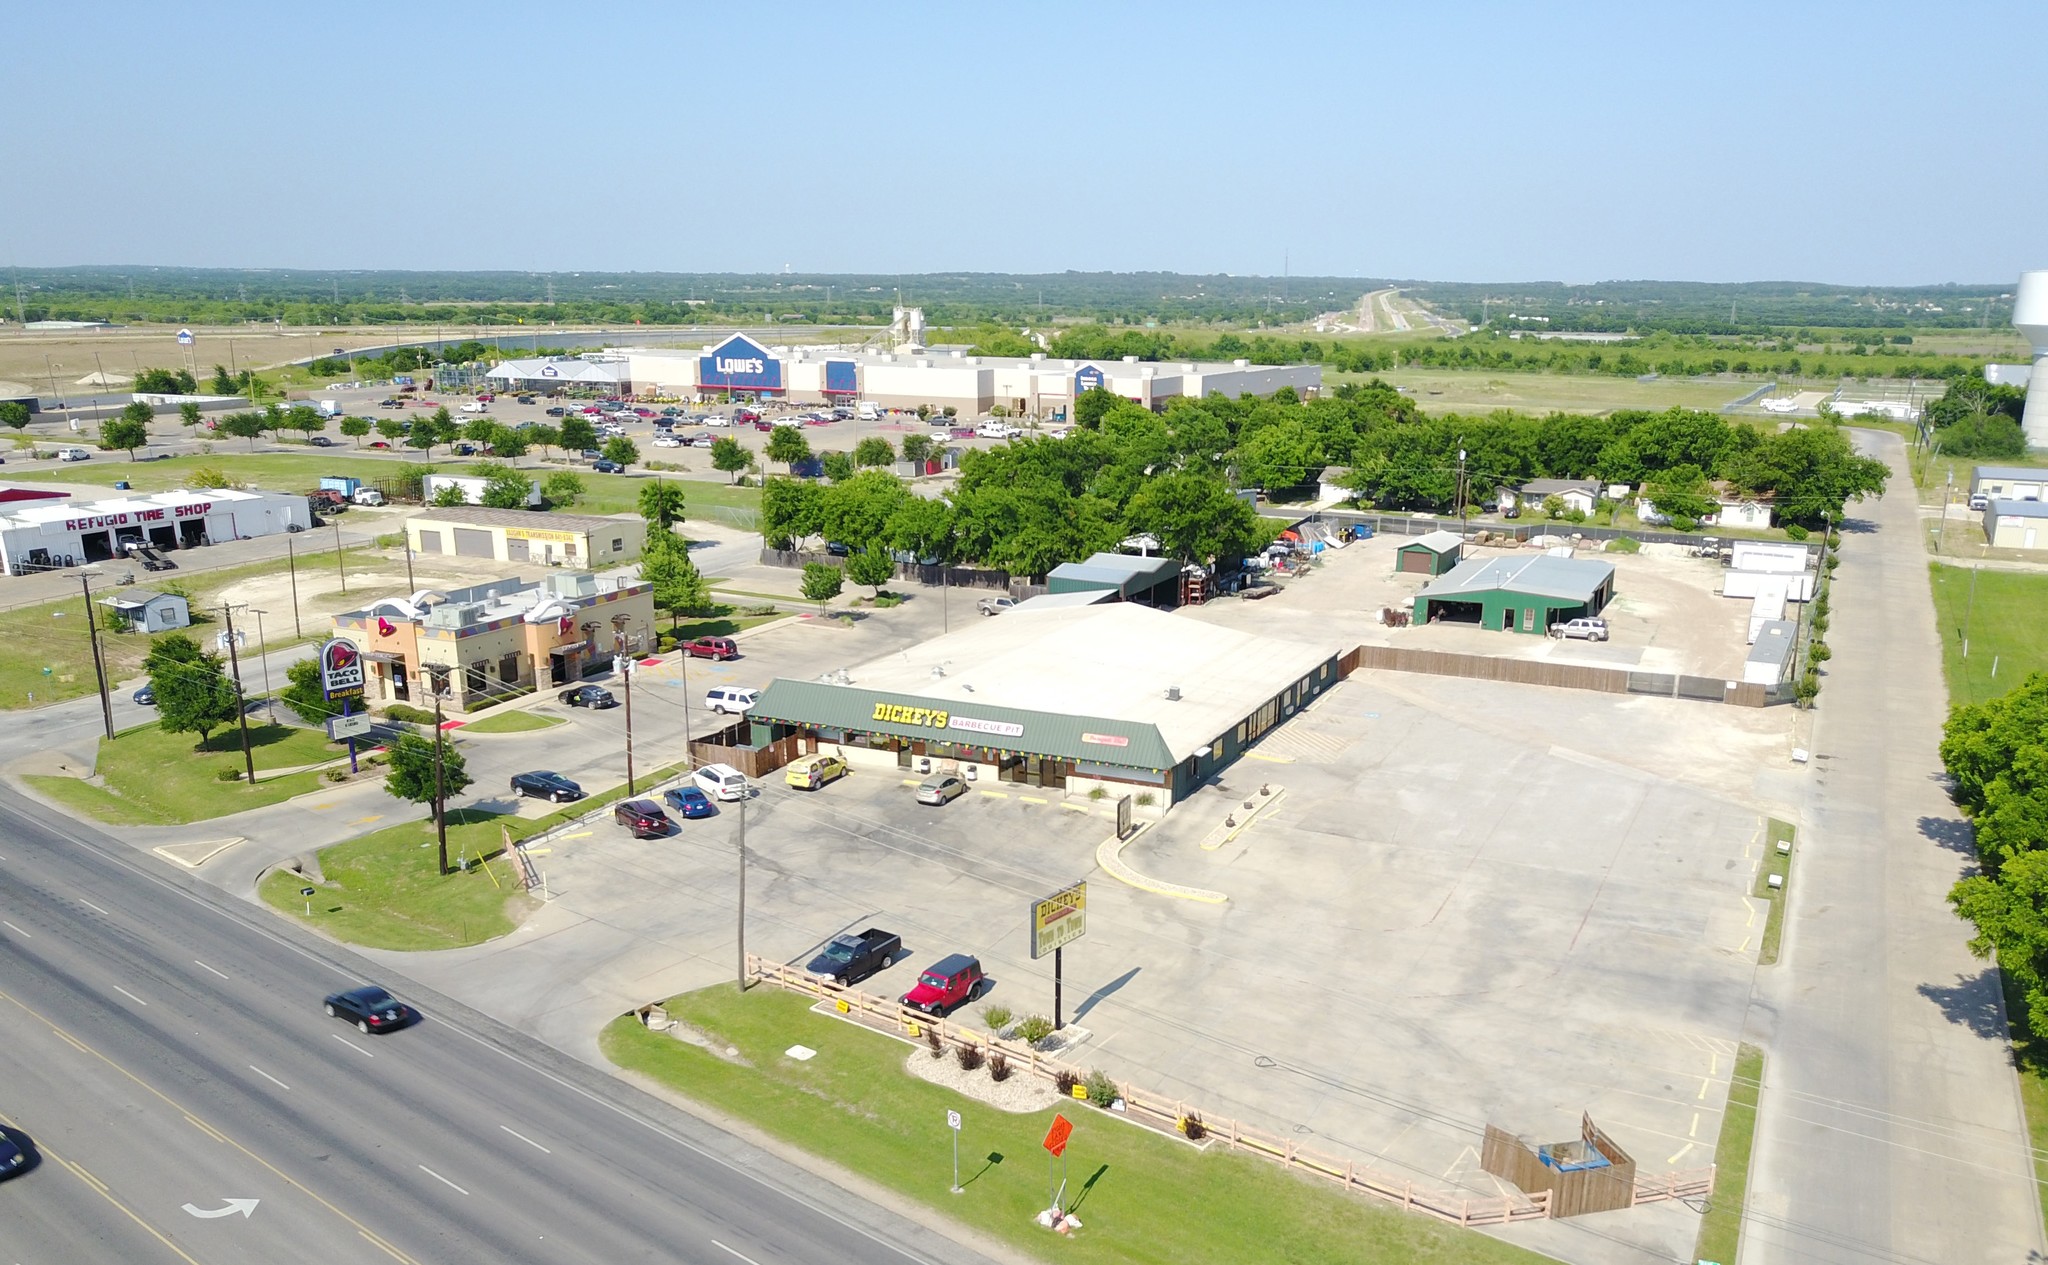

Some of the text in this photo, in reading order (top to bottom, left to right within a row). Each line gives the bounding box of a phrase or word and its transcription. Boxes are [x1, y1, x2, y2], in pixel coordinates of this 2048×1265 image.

[66, 503, 211, 531] REFUGIO TIRE SHOP
[327, 669, 359, 679] TACO
[331, 677, 361, 687] BELL
[330, 687, 362, 699] Breakfast
[952, 719, 1002, 731] BARBECUE
[1005, 724, 1020, 734] PIT
